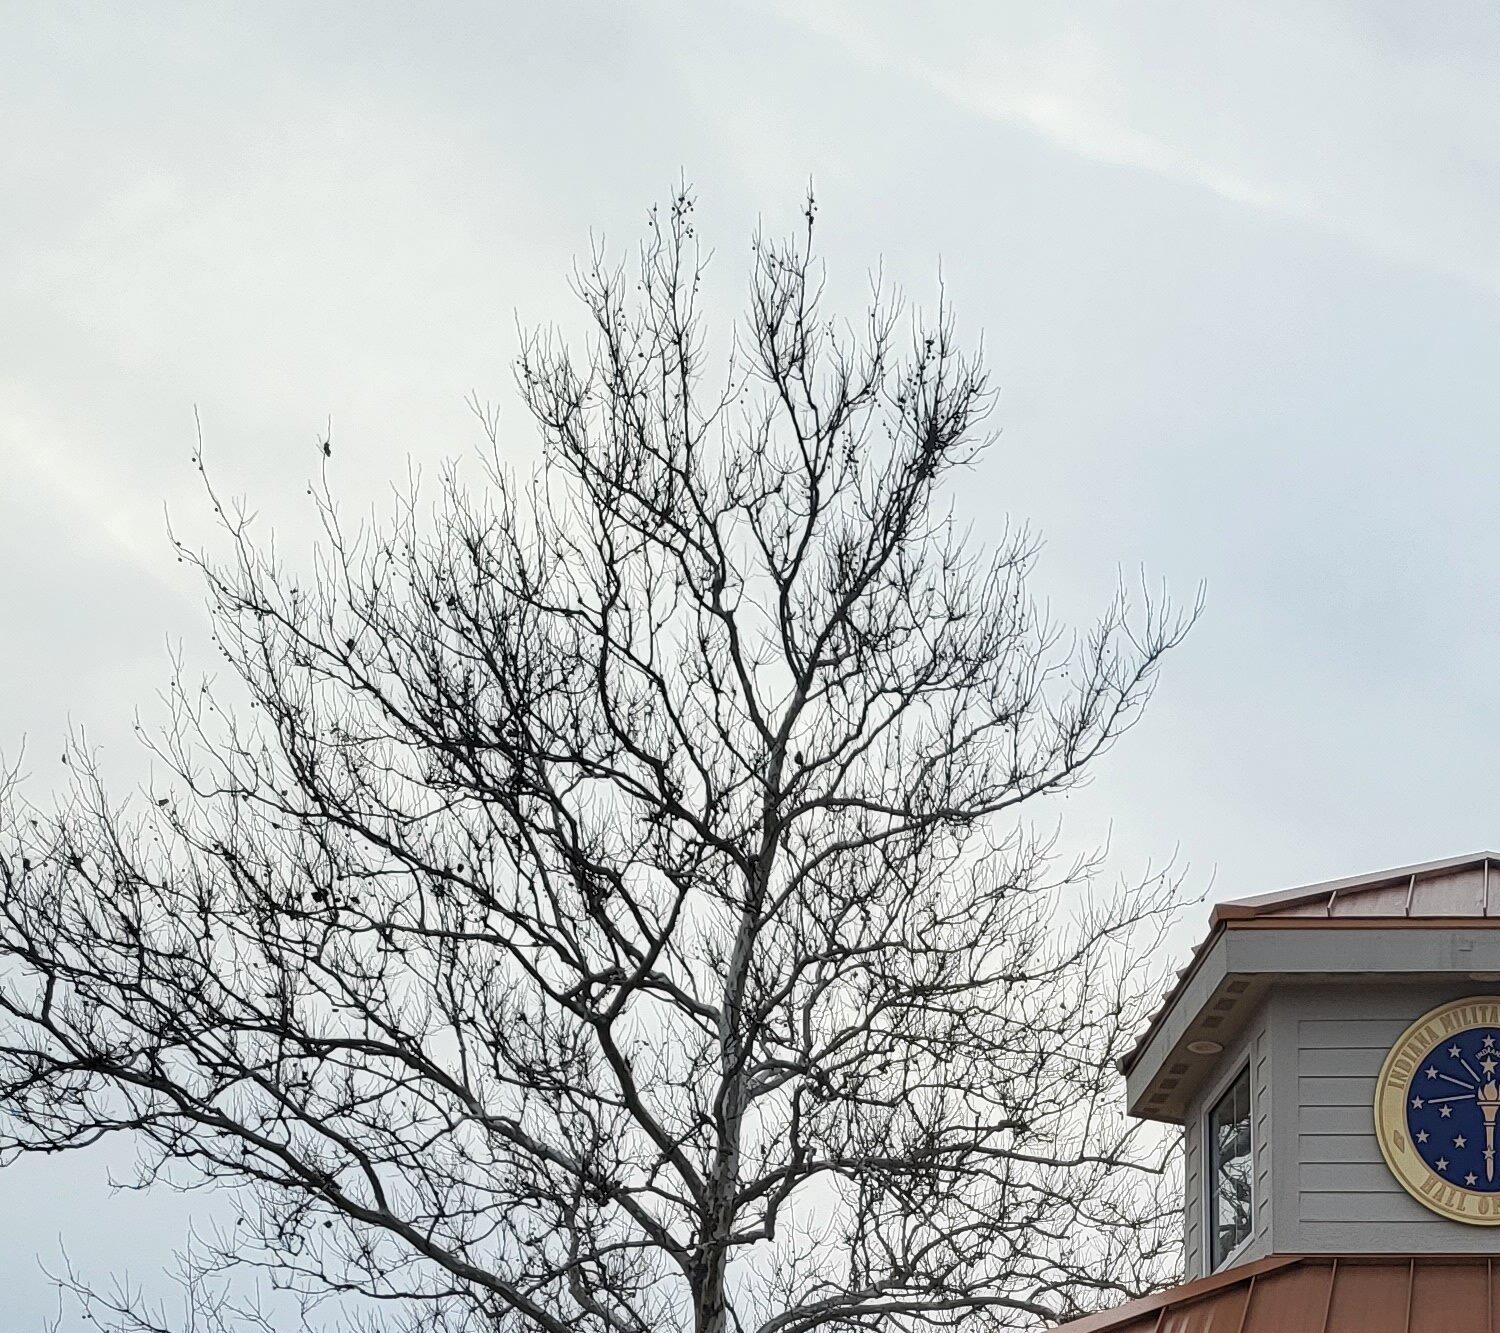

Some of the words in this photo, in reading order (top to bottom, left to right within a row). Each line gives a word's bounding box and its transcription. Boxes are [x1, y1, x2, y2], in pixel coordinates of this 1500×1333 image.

[1387, 1025, 1438, 1090] INDIANA
[1419, 1173, 1466, 1213] HALL
[1477, 1194, 1500, 1215] OF
